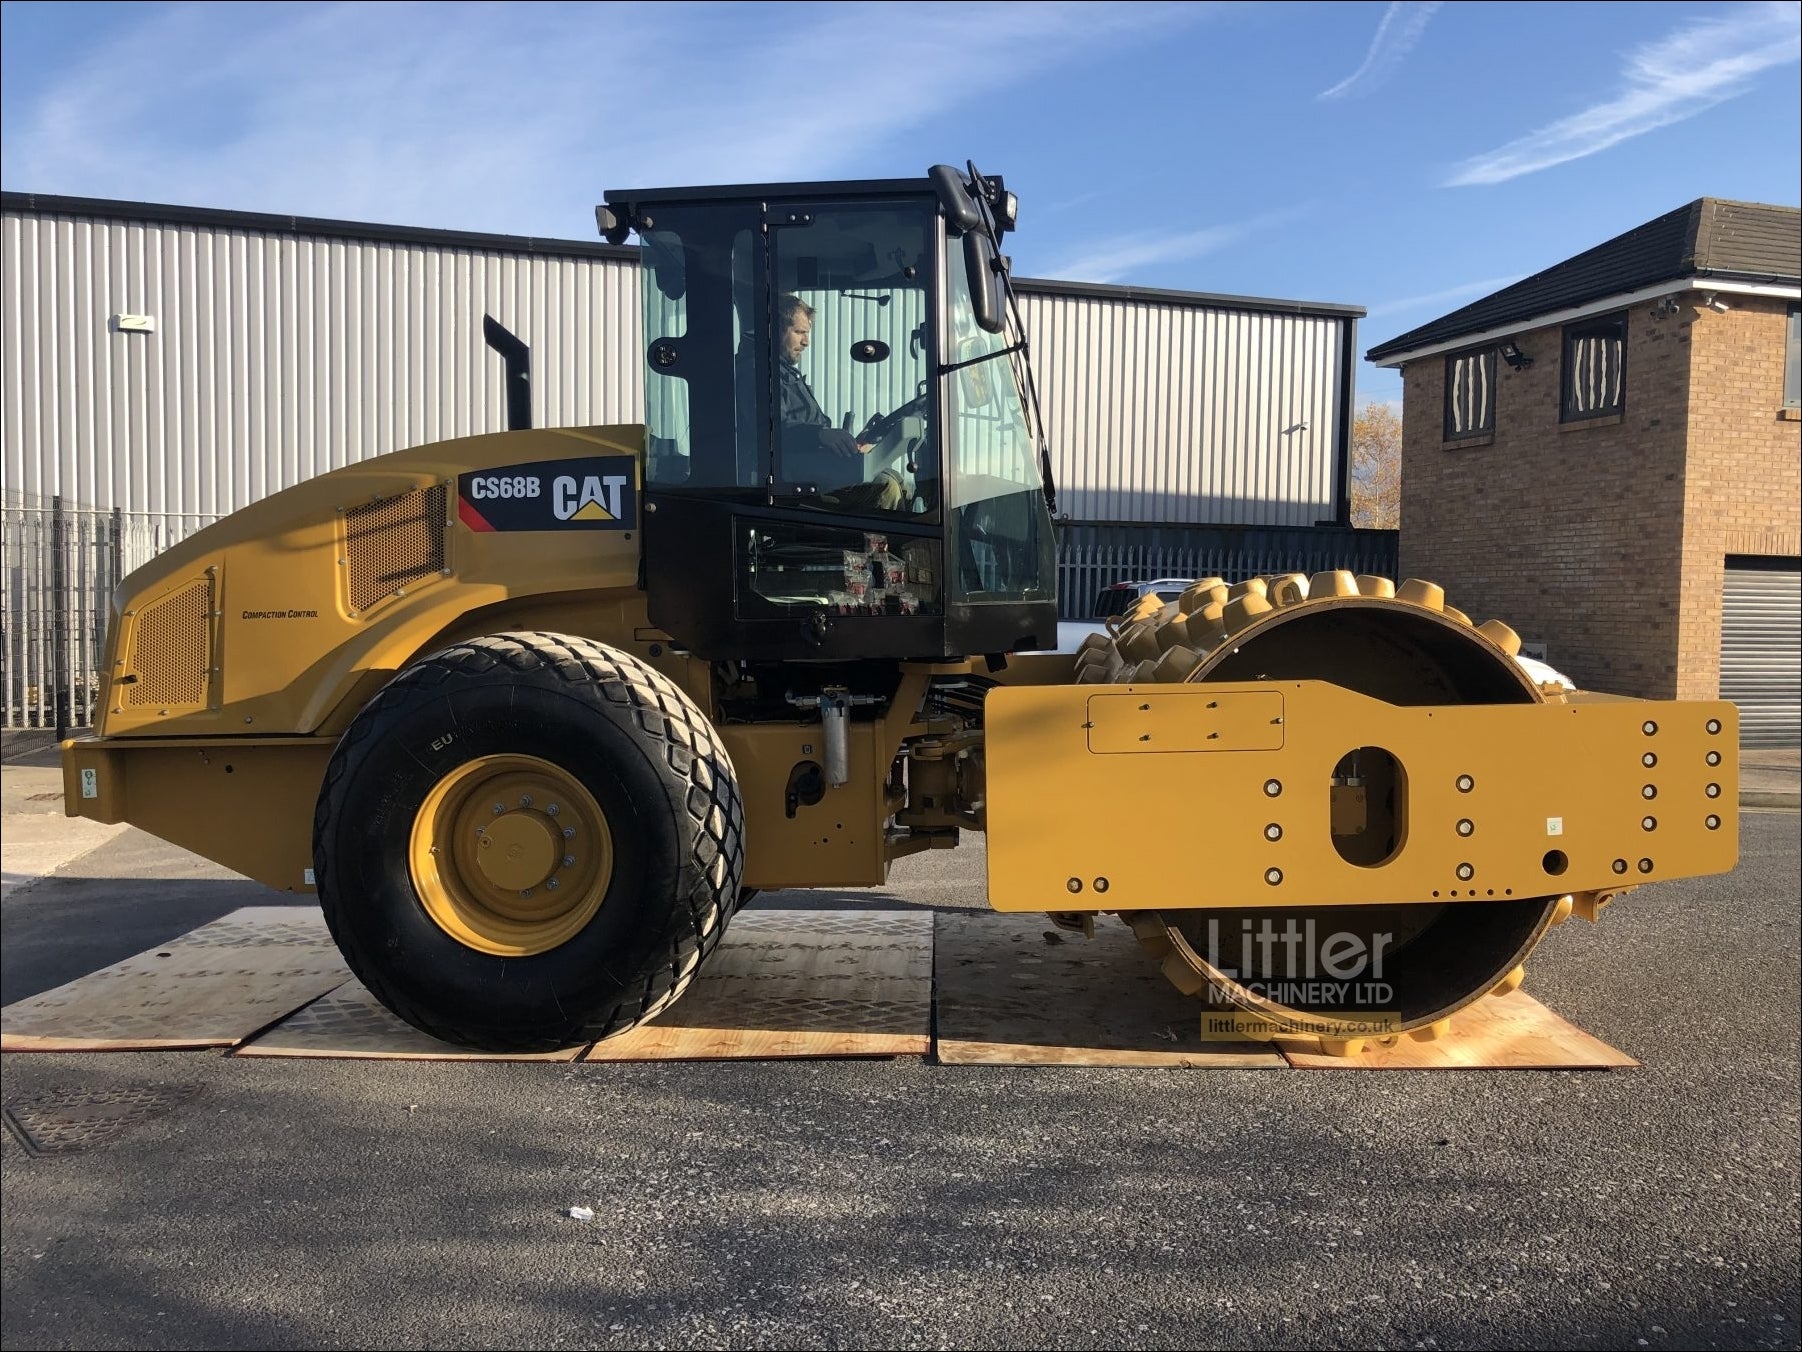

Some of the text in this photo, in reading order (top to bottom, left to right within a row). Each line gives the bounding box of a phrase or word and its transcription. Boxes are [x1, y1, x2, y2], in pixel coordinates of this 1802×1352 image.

[471, 476, 541, 500] CS68B
[552, 475, 627, 521] CAT
[242, 609, 318, 619] COMPACTION CONTROL
